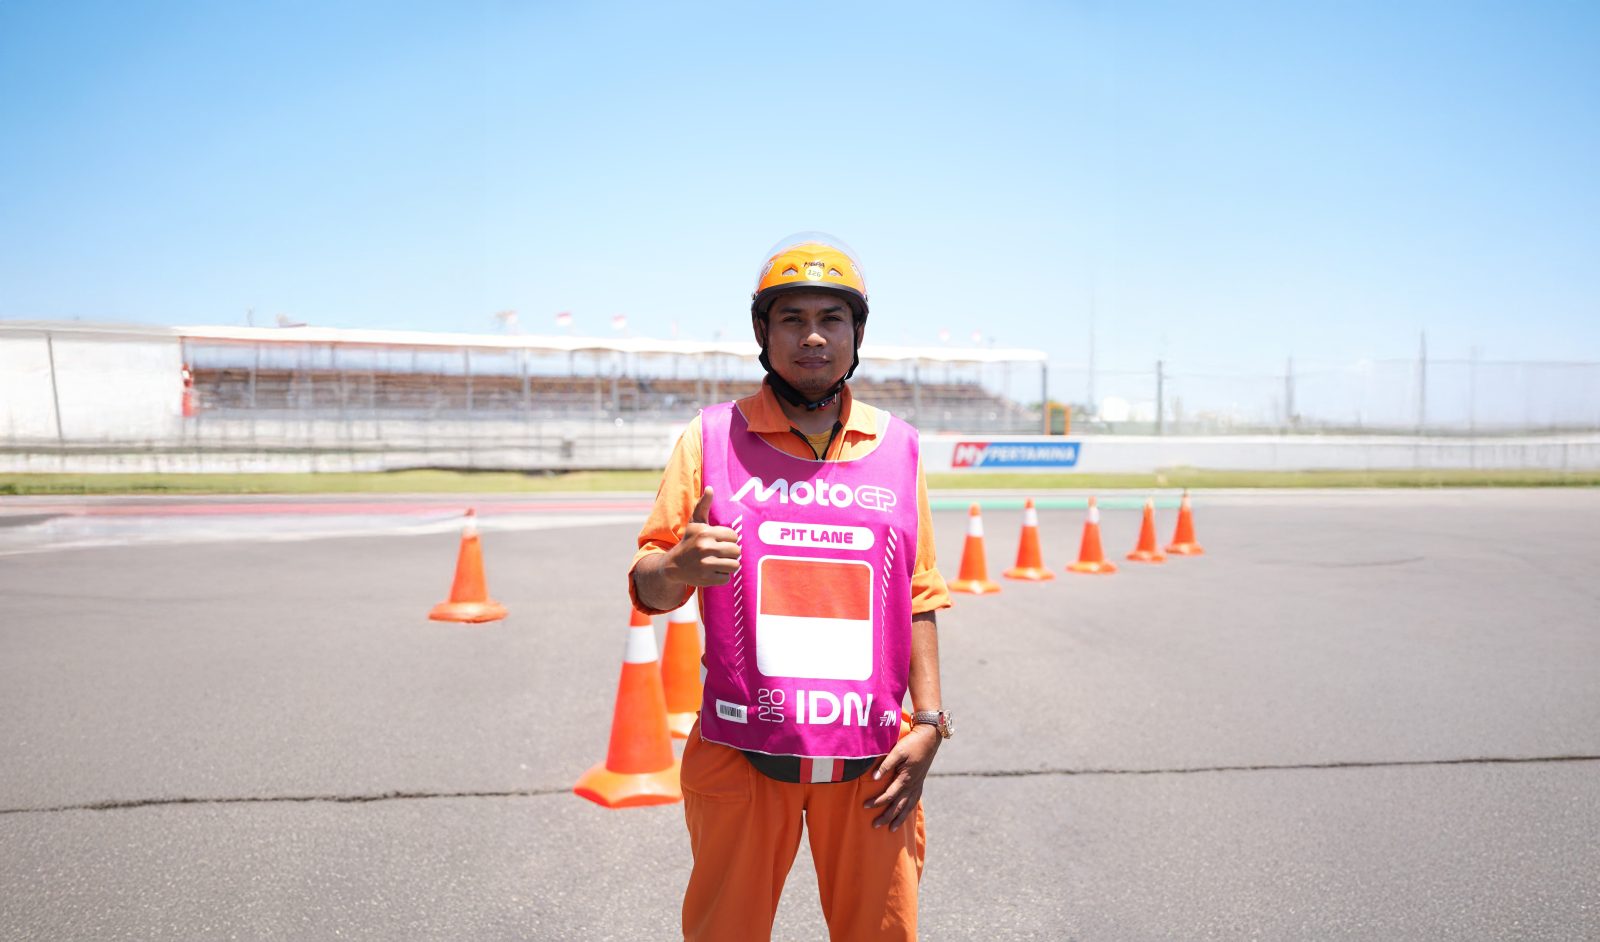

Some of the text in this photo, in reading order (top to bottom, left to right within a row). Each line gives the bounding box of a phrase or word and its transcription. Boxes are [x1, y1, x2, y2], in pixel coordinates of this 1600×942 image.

[729, 476, 897, 512] MotoGP
[780, 528, 853, 544] PIT LANE
[757, 688, 785, 705] 20
[758, 705, 785, 723] 25
[796, 689, 873, 727] IDN
